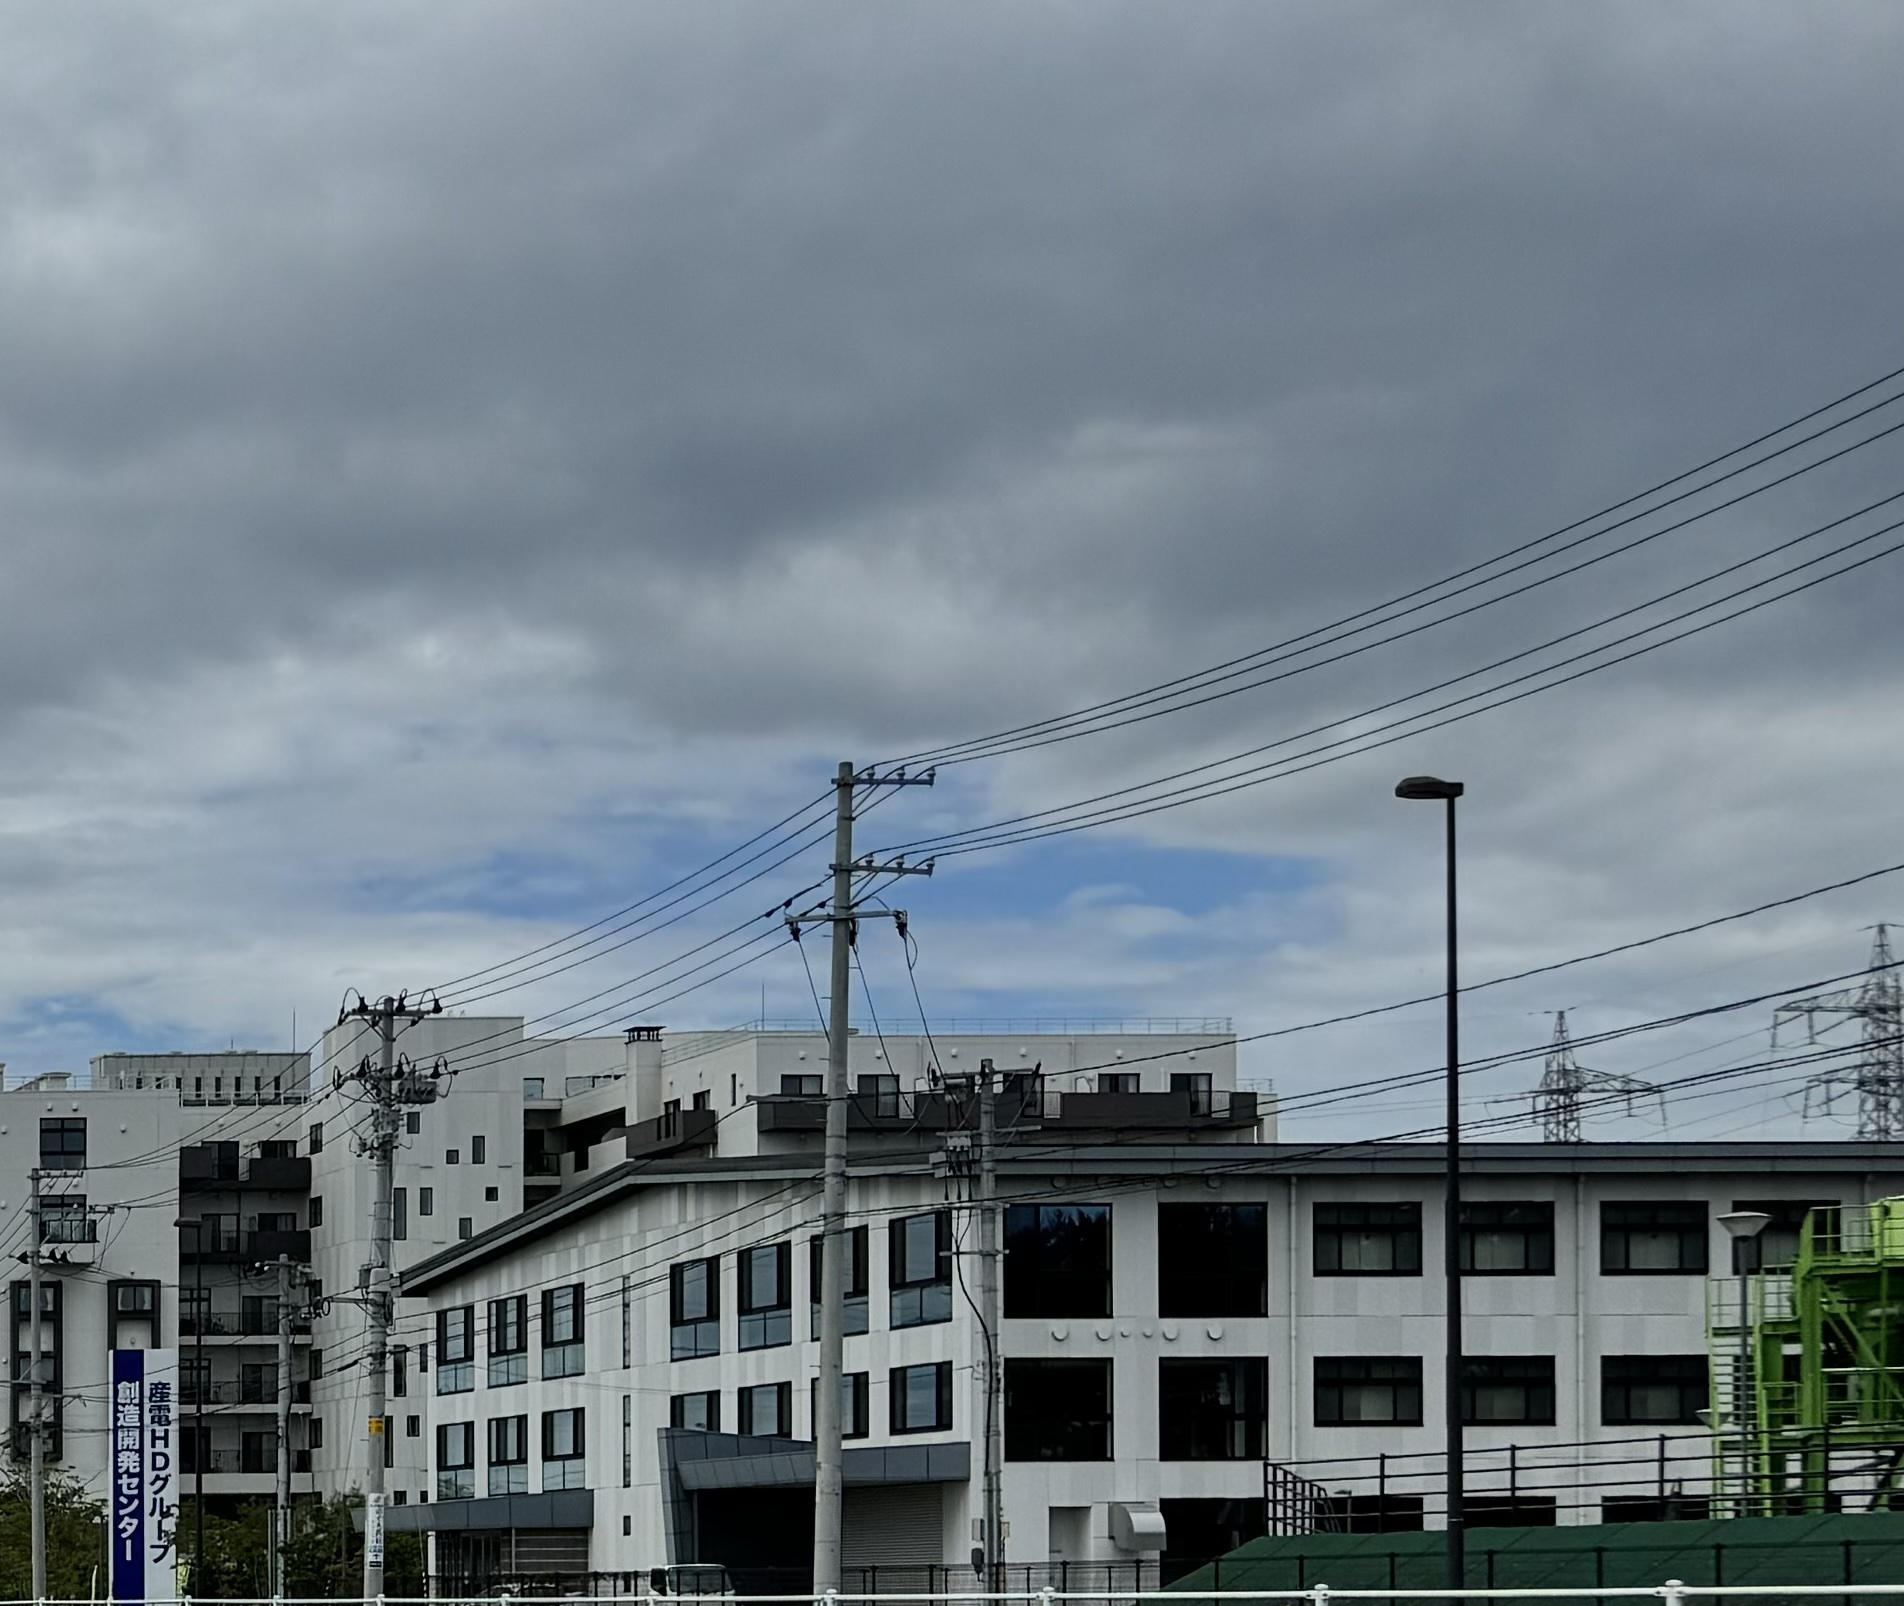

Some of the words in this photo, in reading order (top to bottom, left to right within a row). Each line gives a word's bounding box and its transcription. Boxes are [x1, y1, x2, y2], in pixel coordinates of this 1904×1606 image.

[117, 1380, 141, 1561] 創造開発センター
